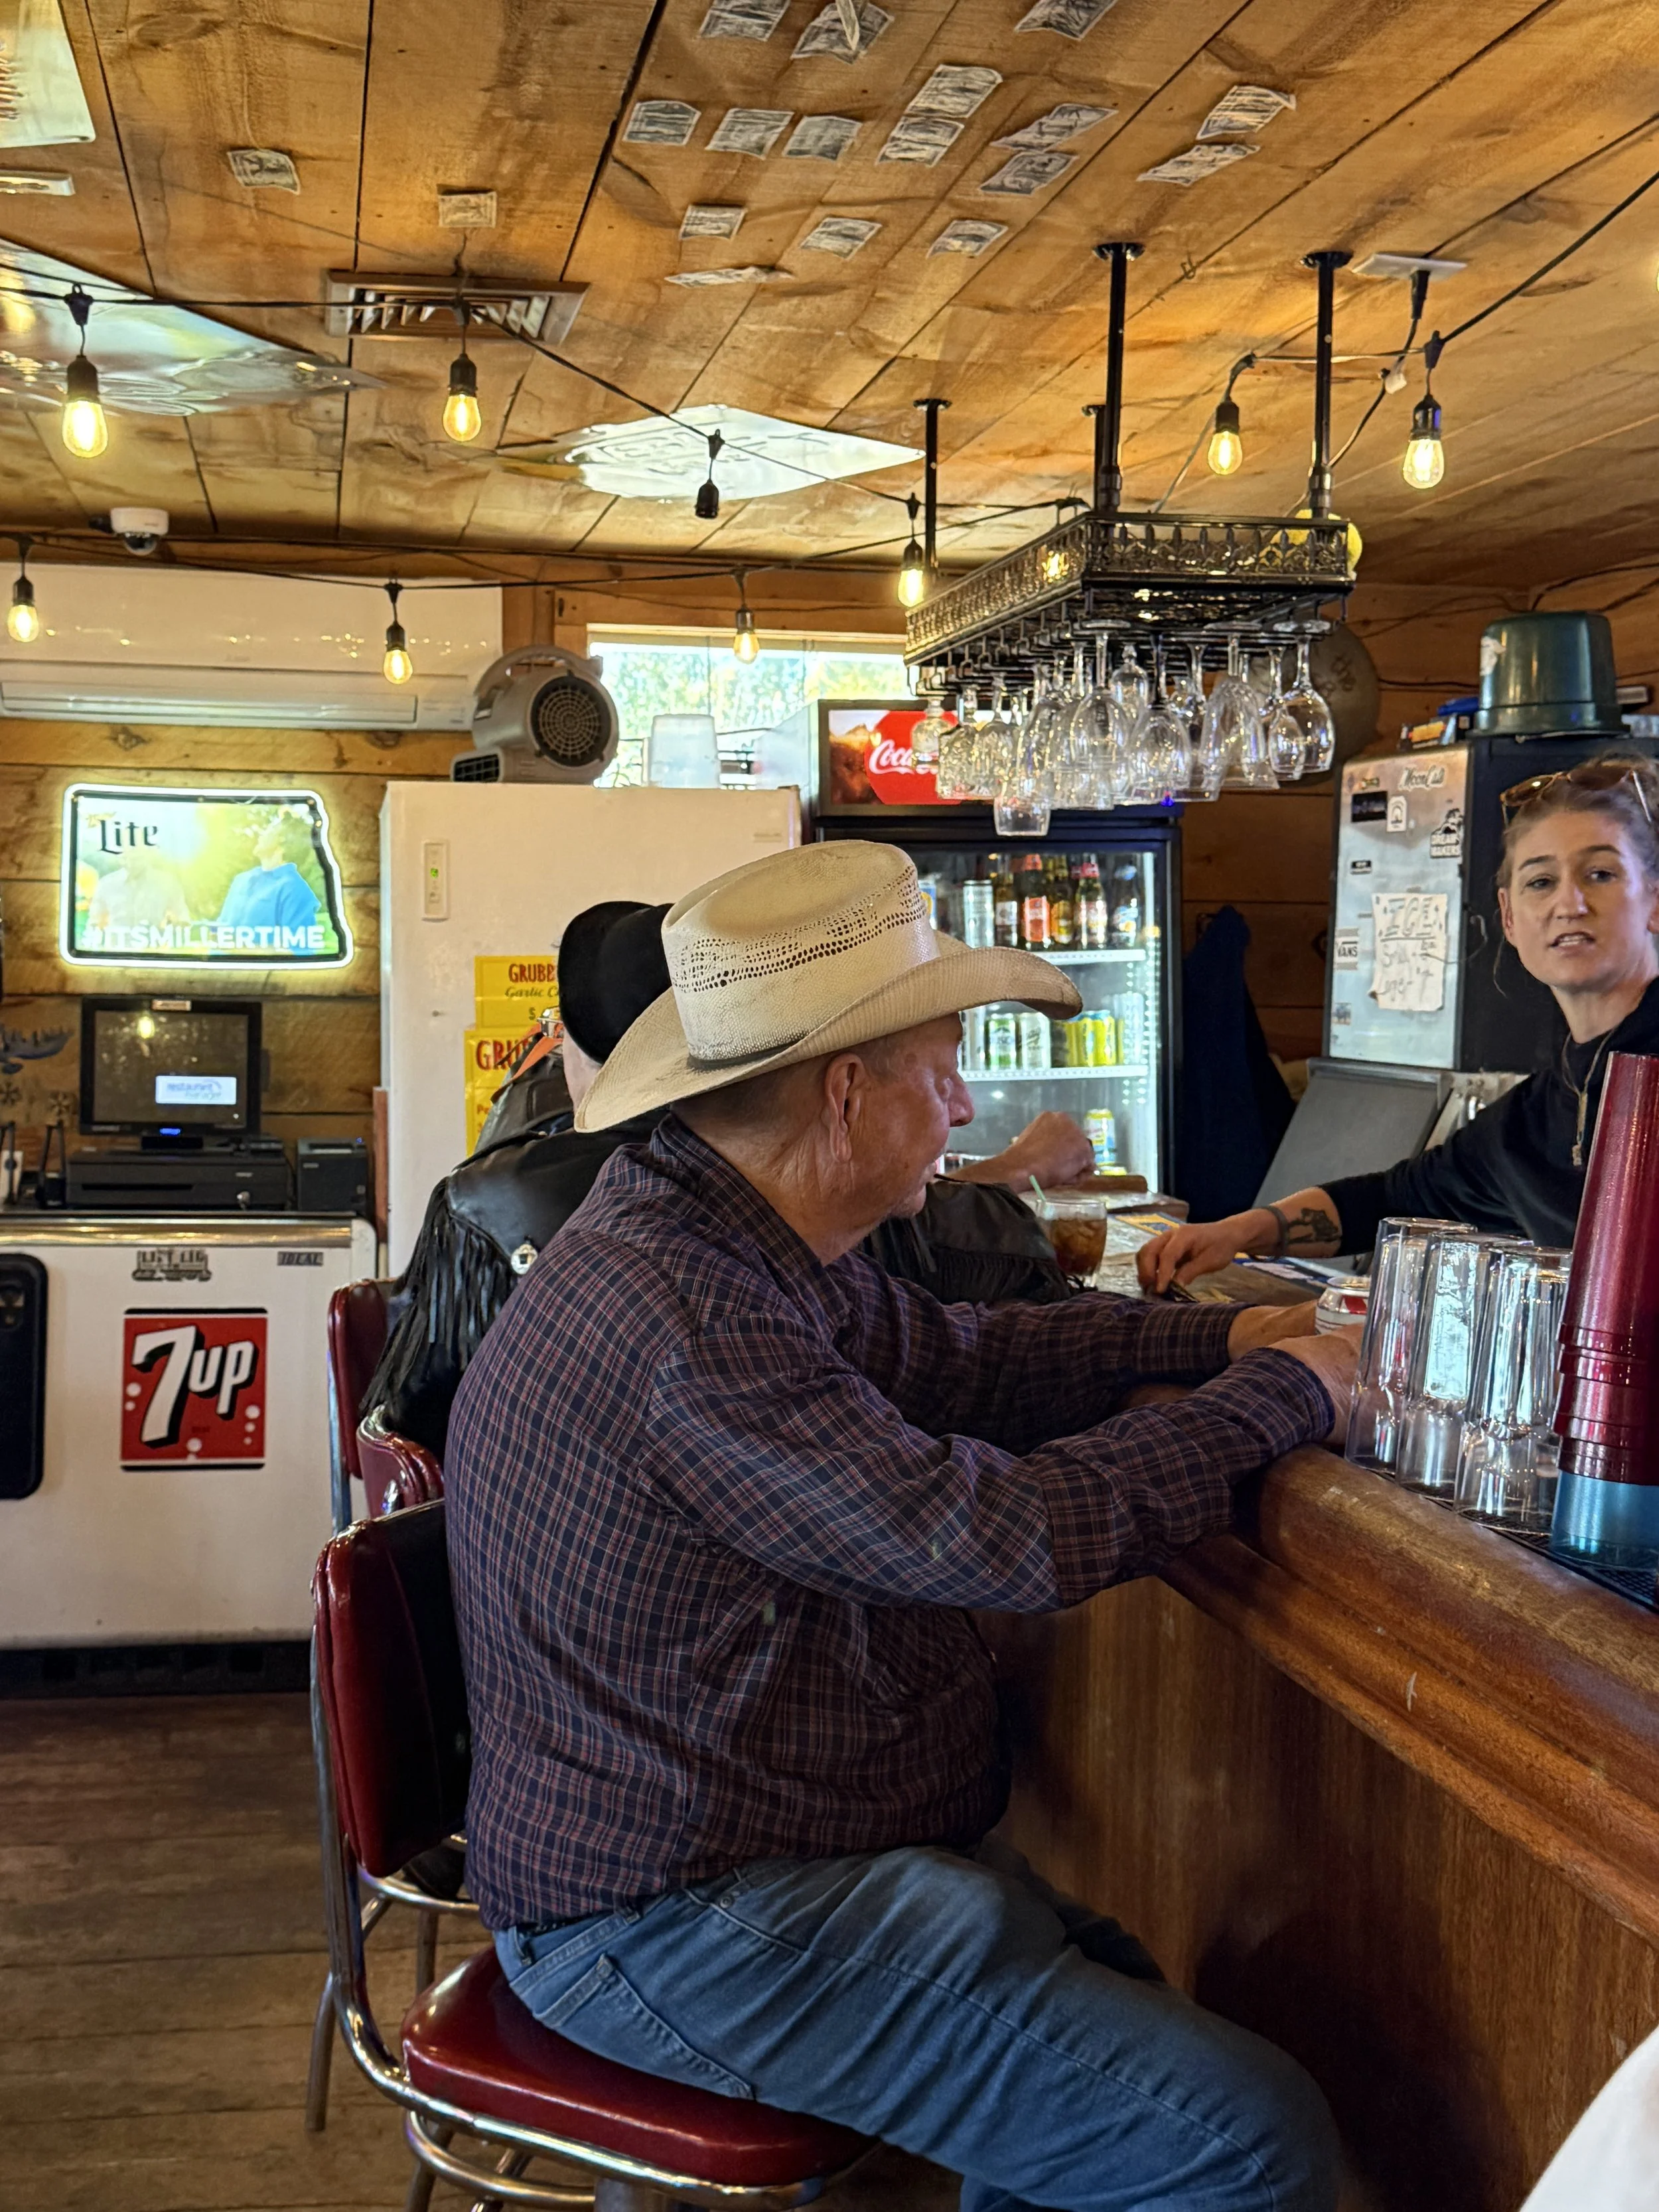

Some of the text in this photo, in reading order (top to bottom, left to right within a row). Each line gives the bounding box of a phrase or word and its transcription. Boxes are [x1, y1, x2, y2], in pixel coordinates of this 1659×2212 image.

[98, 819, 159, 854] Lite
[1334, 940, 1358, 957] VANS
[281, 1252, 321, 1266] IDEAL
